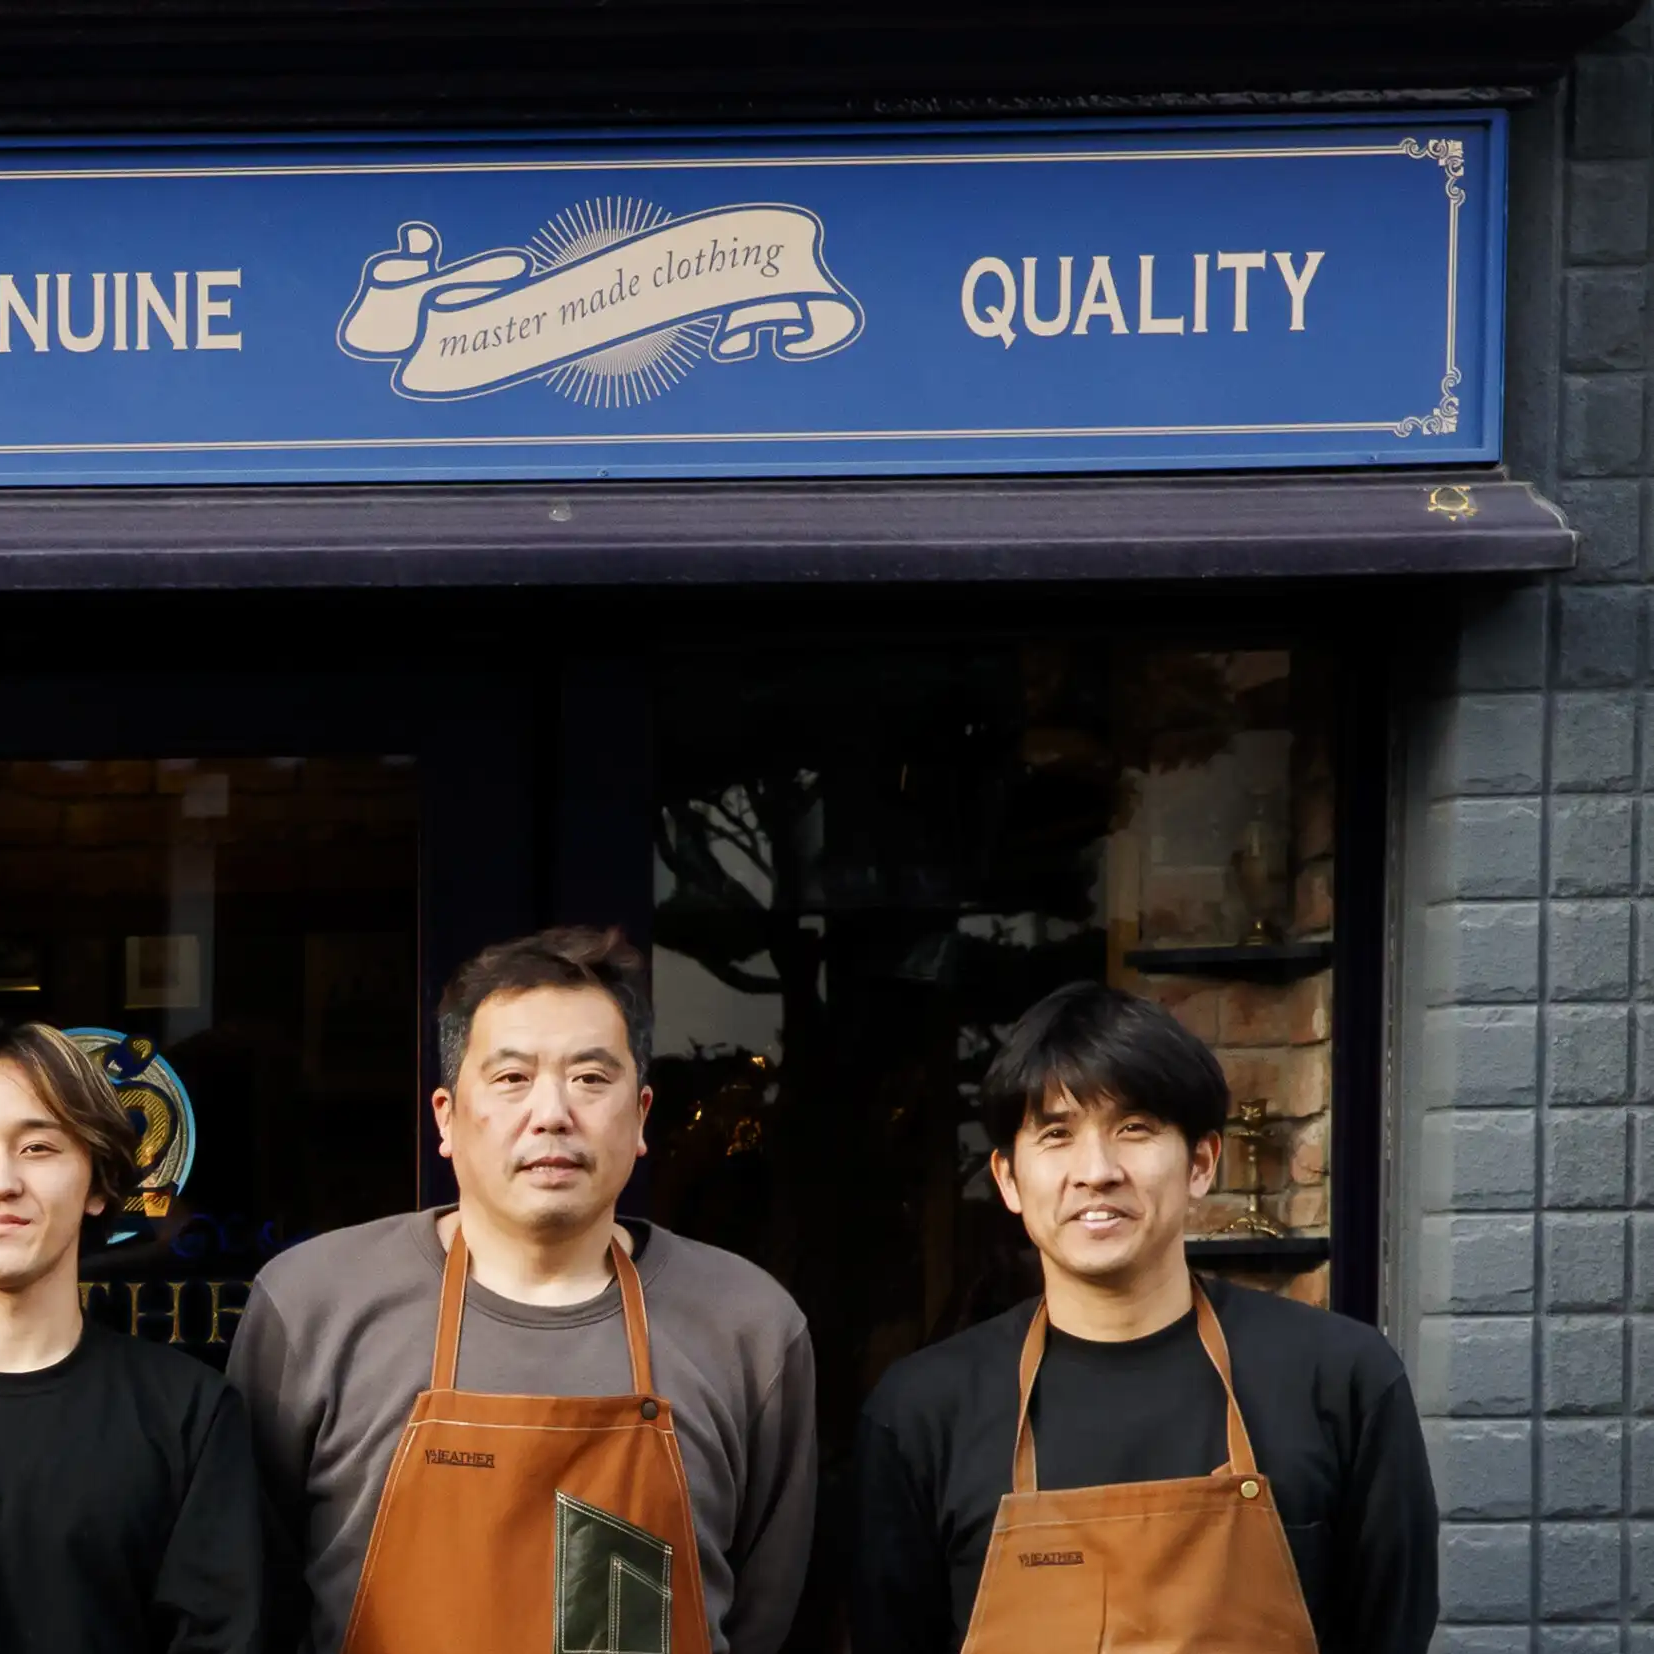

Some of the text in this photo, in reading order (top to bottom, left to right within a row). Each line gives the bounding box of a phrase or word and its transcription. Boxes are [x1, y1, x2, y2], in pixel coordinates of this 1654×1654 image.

[439, 237, 785, 357] master made clothing
[961, 250, 1325, 350] QUALITY
